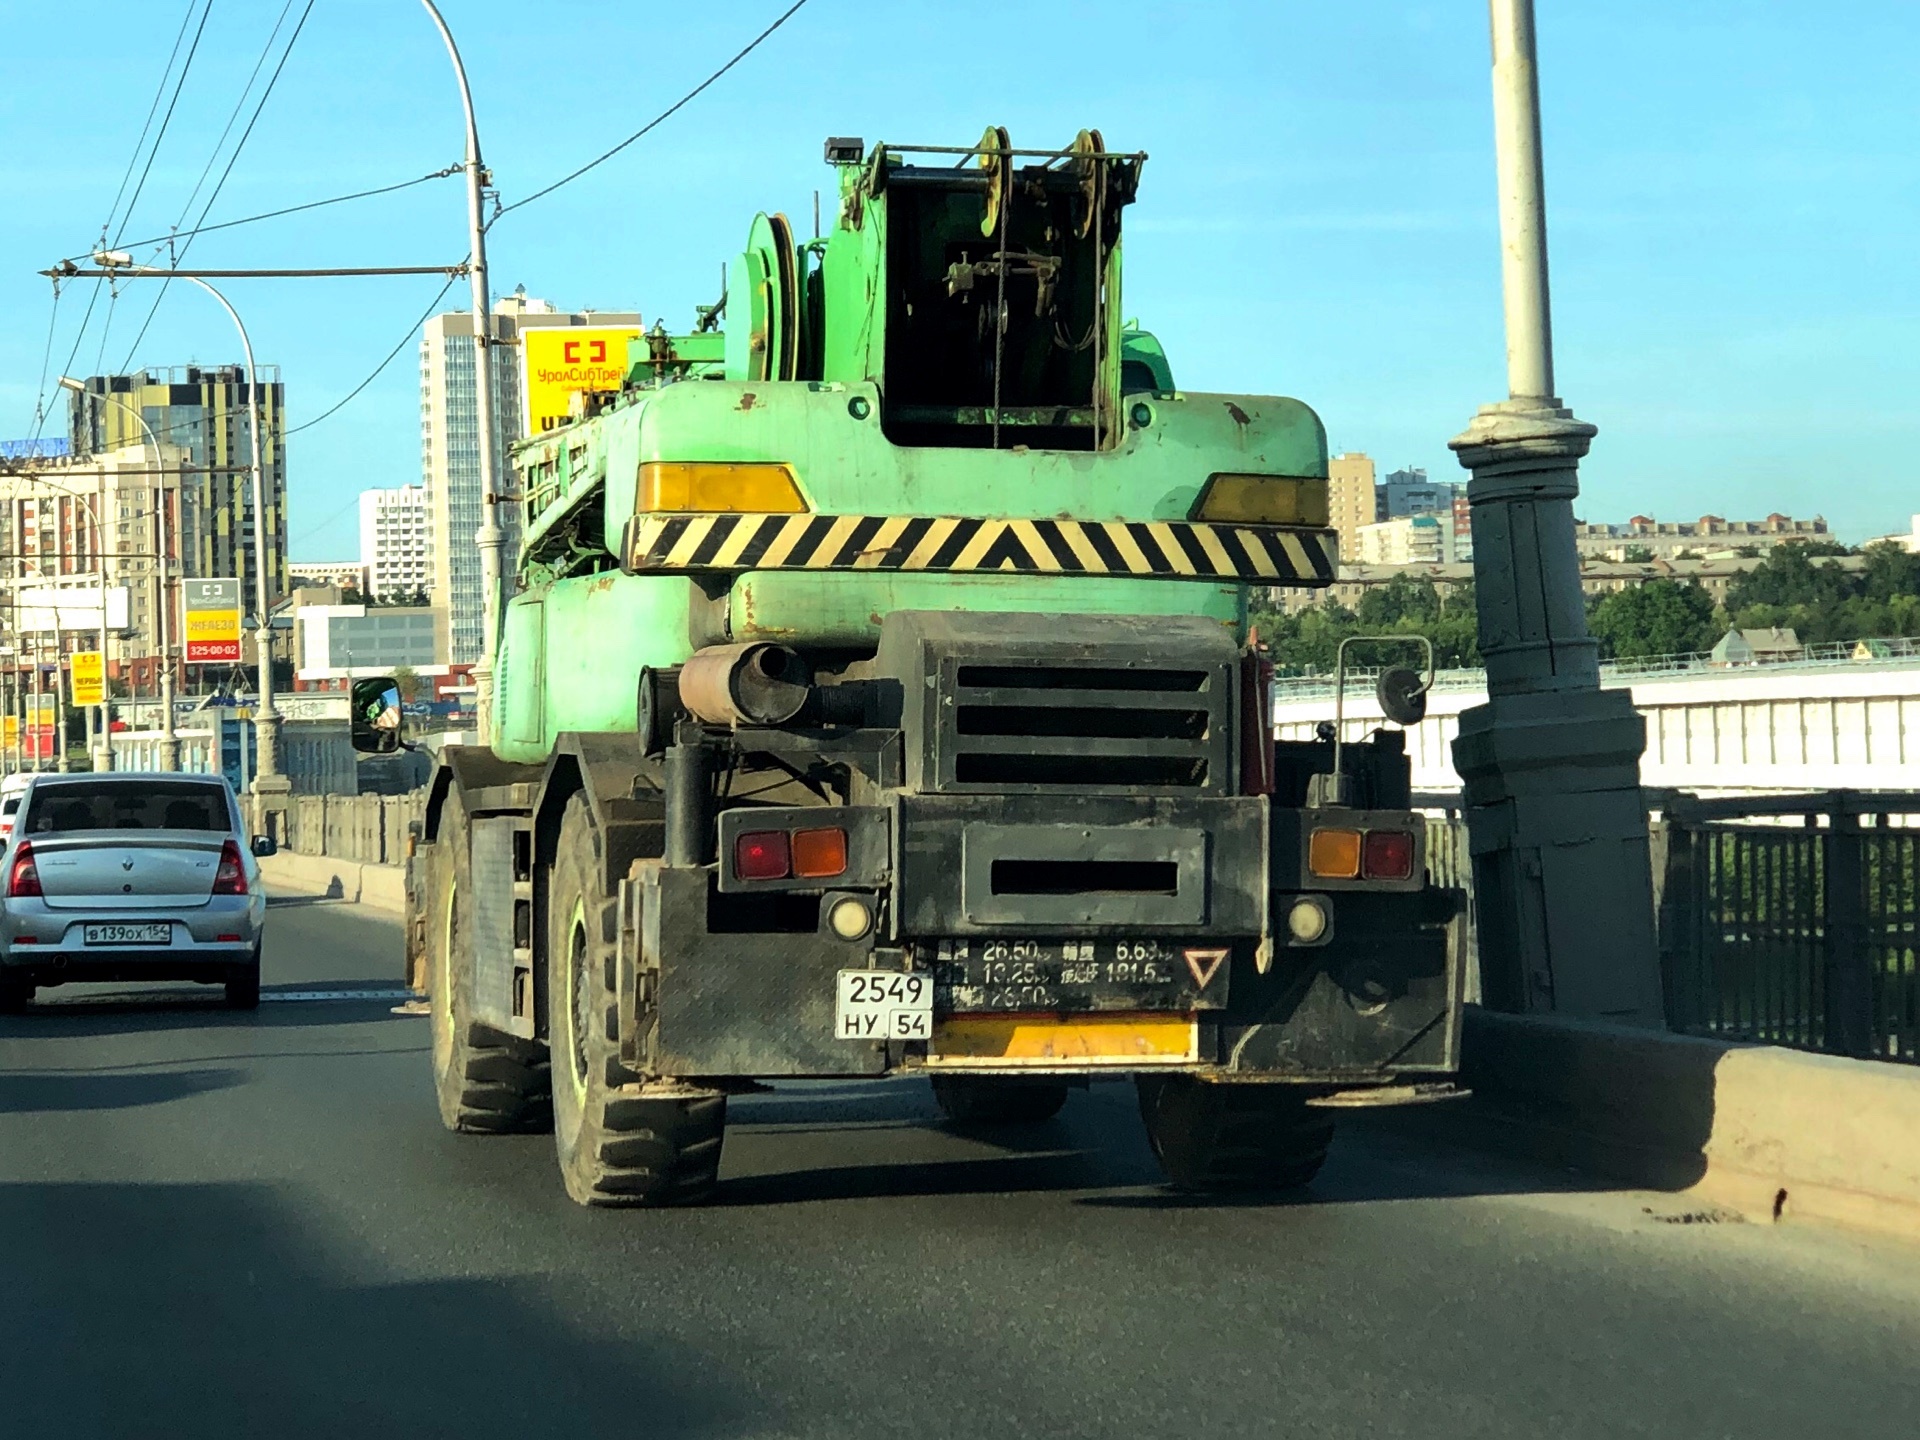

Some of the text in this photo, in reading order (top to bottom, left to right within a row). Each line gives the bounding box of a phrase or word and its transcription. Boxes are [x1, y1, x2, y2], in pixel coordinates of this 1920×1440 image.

[537, 366, 628, 384] УралСибТрей
[190, 645, 237, 656] 325-00-02
[849, 976, 923, 1004] 2549
[844, 1013, 925, 1036] НУ 54
